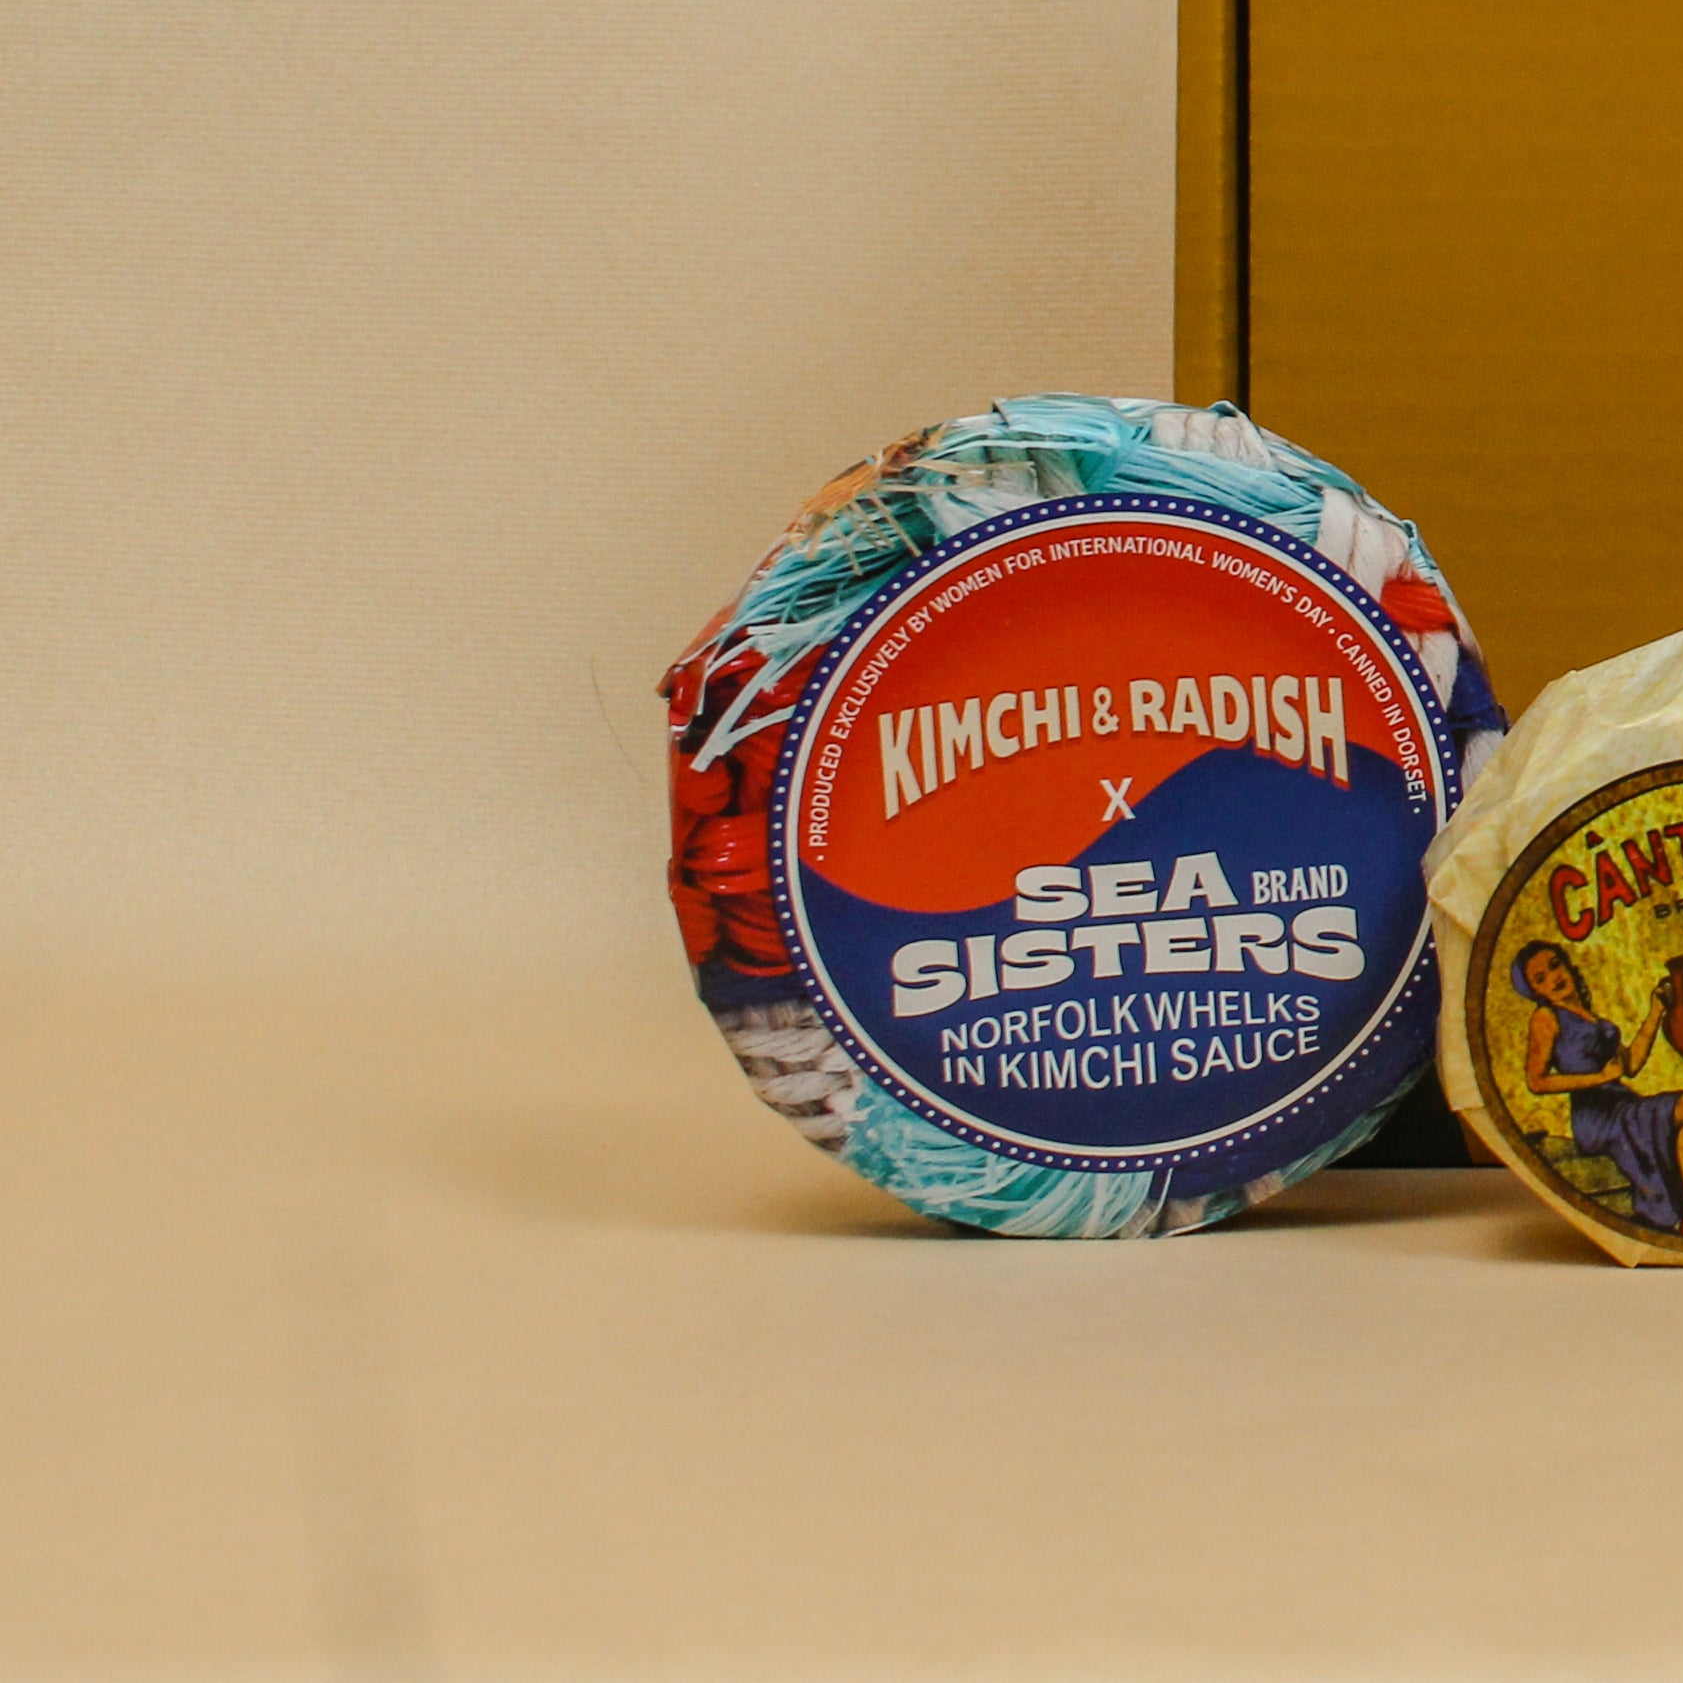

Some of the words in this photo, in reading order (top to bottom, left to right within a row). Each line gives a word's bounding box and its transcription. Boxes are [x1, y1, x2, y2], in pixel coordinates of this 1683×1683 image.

[808, 742, 843, 847] PRODUCED
[829, 626, 913, 740] EXCLUSIVELY
[906, 606, 934, 634] BY
[929, 564, 1004, 614] WOMEN
[1003, 547, 1047, 575] FOR
[1049, 535, 1206, 565] INTERNATIONAL
[1211, 550, 1299, 604] WOMEN'S
[1294, 595, 1334, 629] DAY
[1335, 632, 1394, 704] CANNED
[877, 684, 1082, 821] KIMCHI
[1092, 686, 1121, 736] &
[1128, 674, 1350, 785] RADISH
[1383, 697, 1407, 728] IN
[1100, 776, 1137, 822] X
[1392, 728, 1428, 804] DORSET
[1014, 850, 1240, 923] SEA
[1250, 864, 1349, 907] BRAND
[891, 905, 1366, 1019] SISTERS
[940, 993, 1140, 1053] NORFOLK
[1143, 990, 1321, 1033] WHELKS
[942, 1054, 986, 1088] IN
[1000, 1041, 1158, 1090] KIMCHI
[1171, 1025, 1321, 1081] SAUCE
